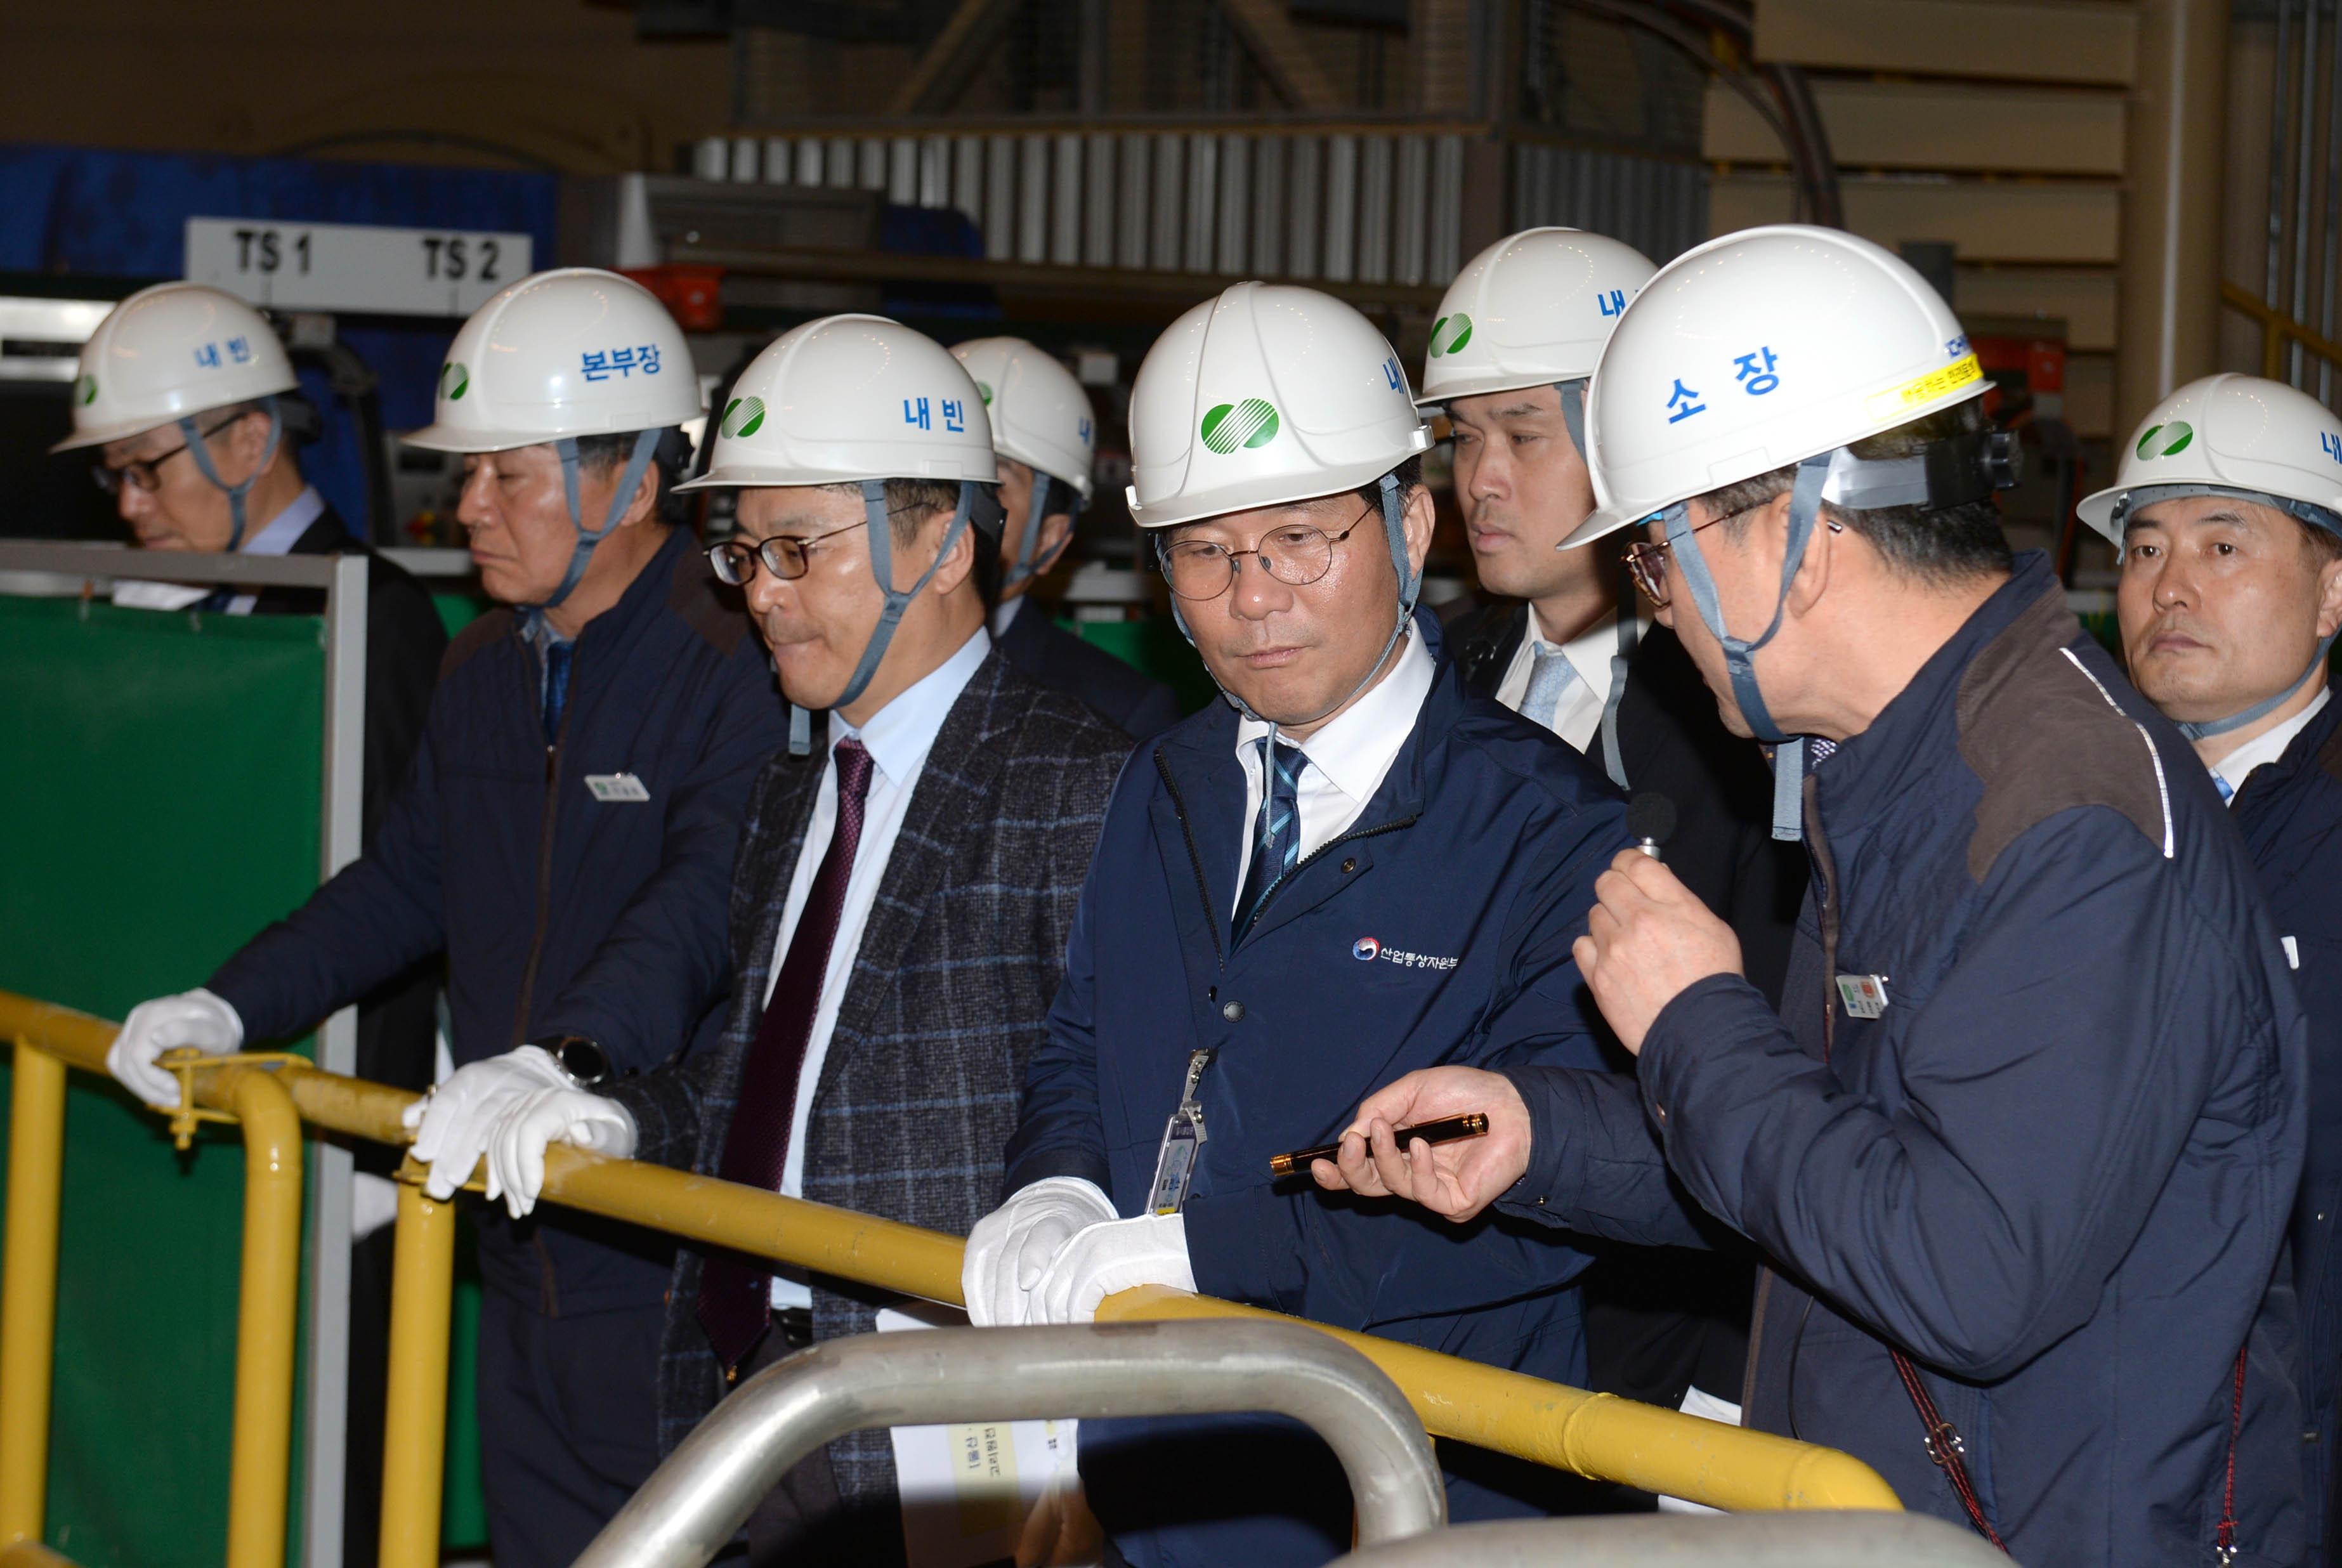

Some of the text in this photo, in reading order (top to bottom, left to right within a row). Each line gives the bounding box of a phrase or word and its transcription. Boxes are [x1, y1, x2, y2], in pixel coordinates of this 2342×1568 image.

[235, 229, 311, 276] TS 1
[422, 237, 500, 282] TS 2
[1597, 289, 1639, 318] 내
[581, 344, 660, 381] 본부장
[1380, 948, 1458, 970] 산업통상자원부
